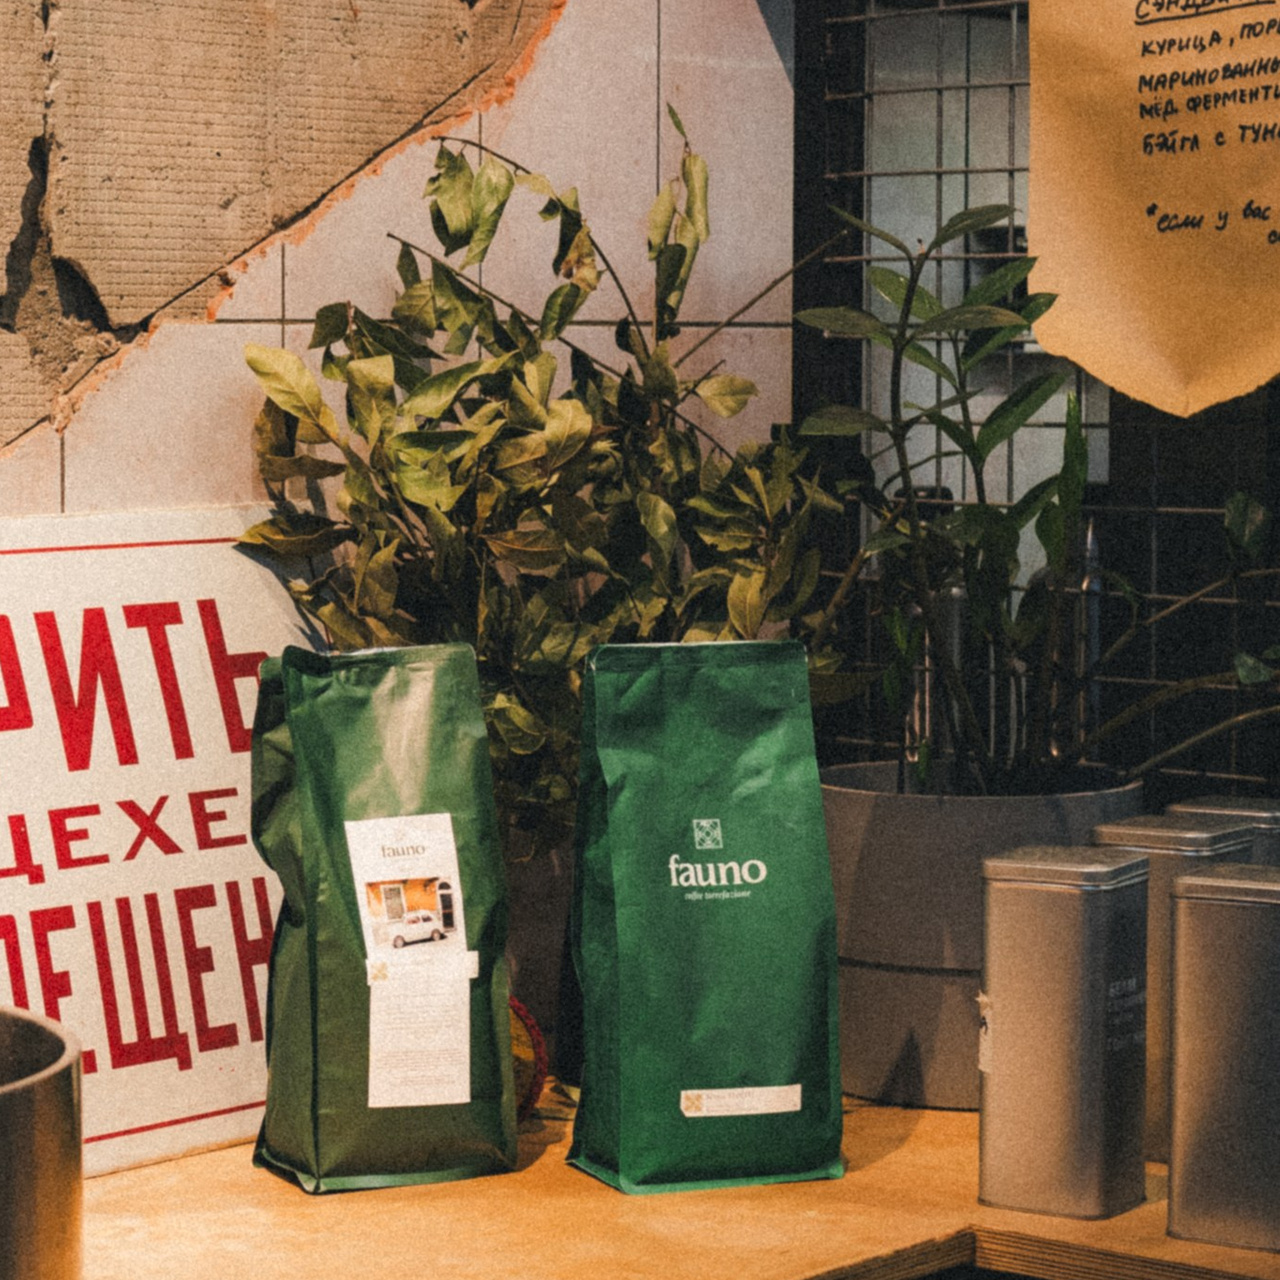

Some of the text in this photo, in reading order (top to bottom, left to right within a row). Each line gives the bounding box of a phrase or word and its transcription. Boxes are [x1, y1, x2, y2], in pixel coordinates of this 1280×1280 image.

[1143, 129, 1200, 156] БЭЙГЛ
[1238, 123, 1280, 143] ТУН
[668, 853, 768, 887] fauno
